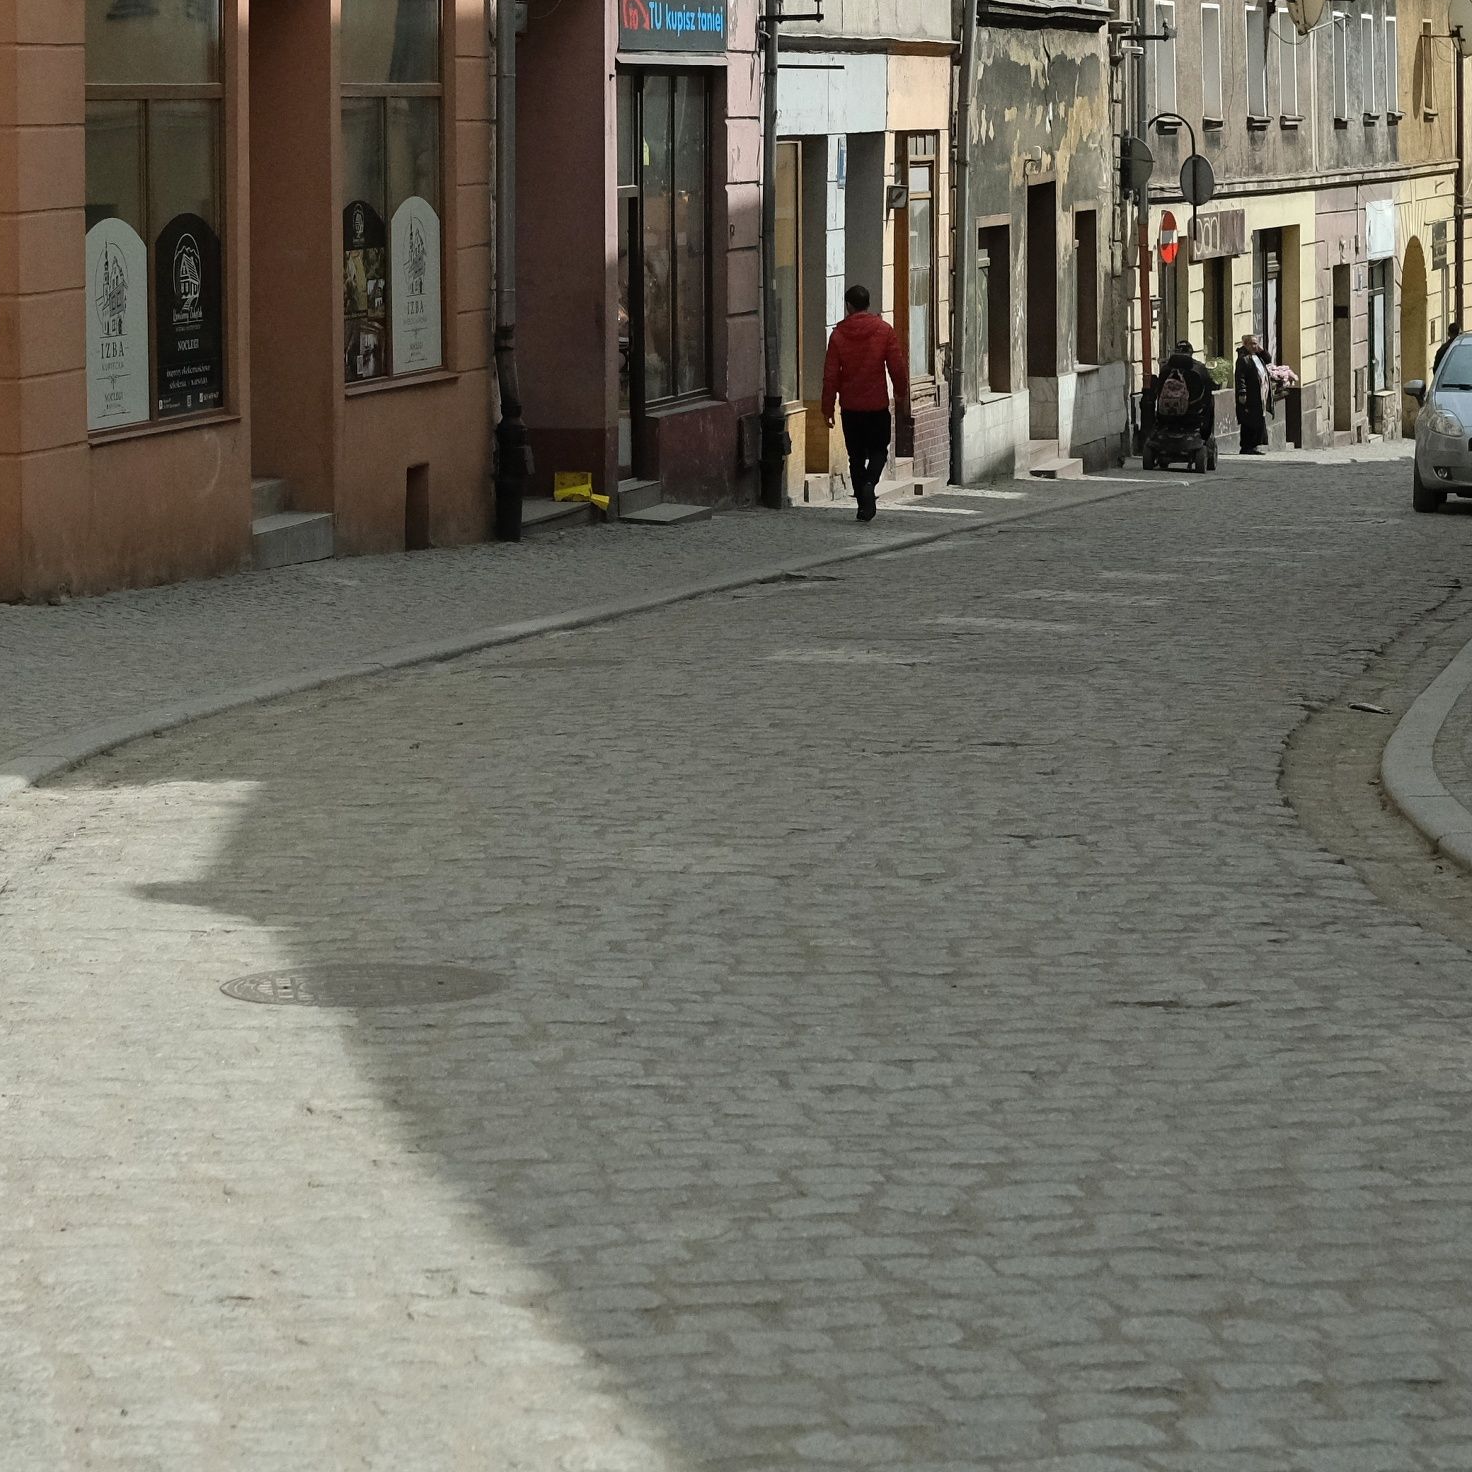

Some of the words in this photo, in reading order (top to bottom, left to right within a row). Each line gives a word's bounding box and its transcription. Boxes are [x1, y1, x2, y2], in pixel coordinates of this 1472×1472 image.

[648, 1, 662, 30] TU
[665, 4, 696, 37] kupisz
[697, 5, 724, 39] taniej
[101, 341, 125, 359] IZBA
